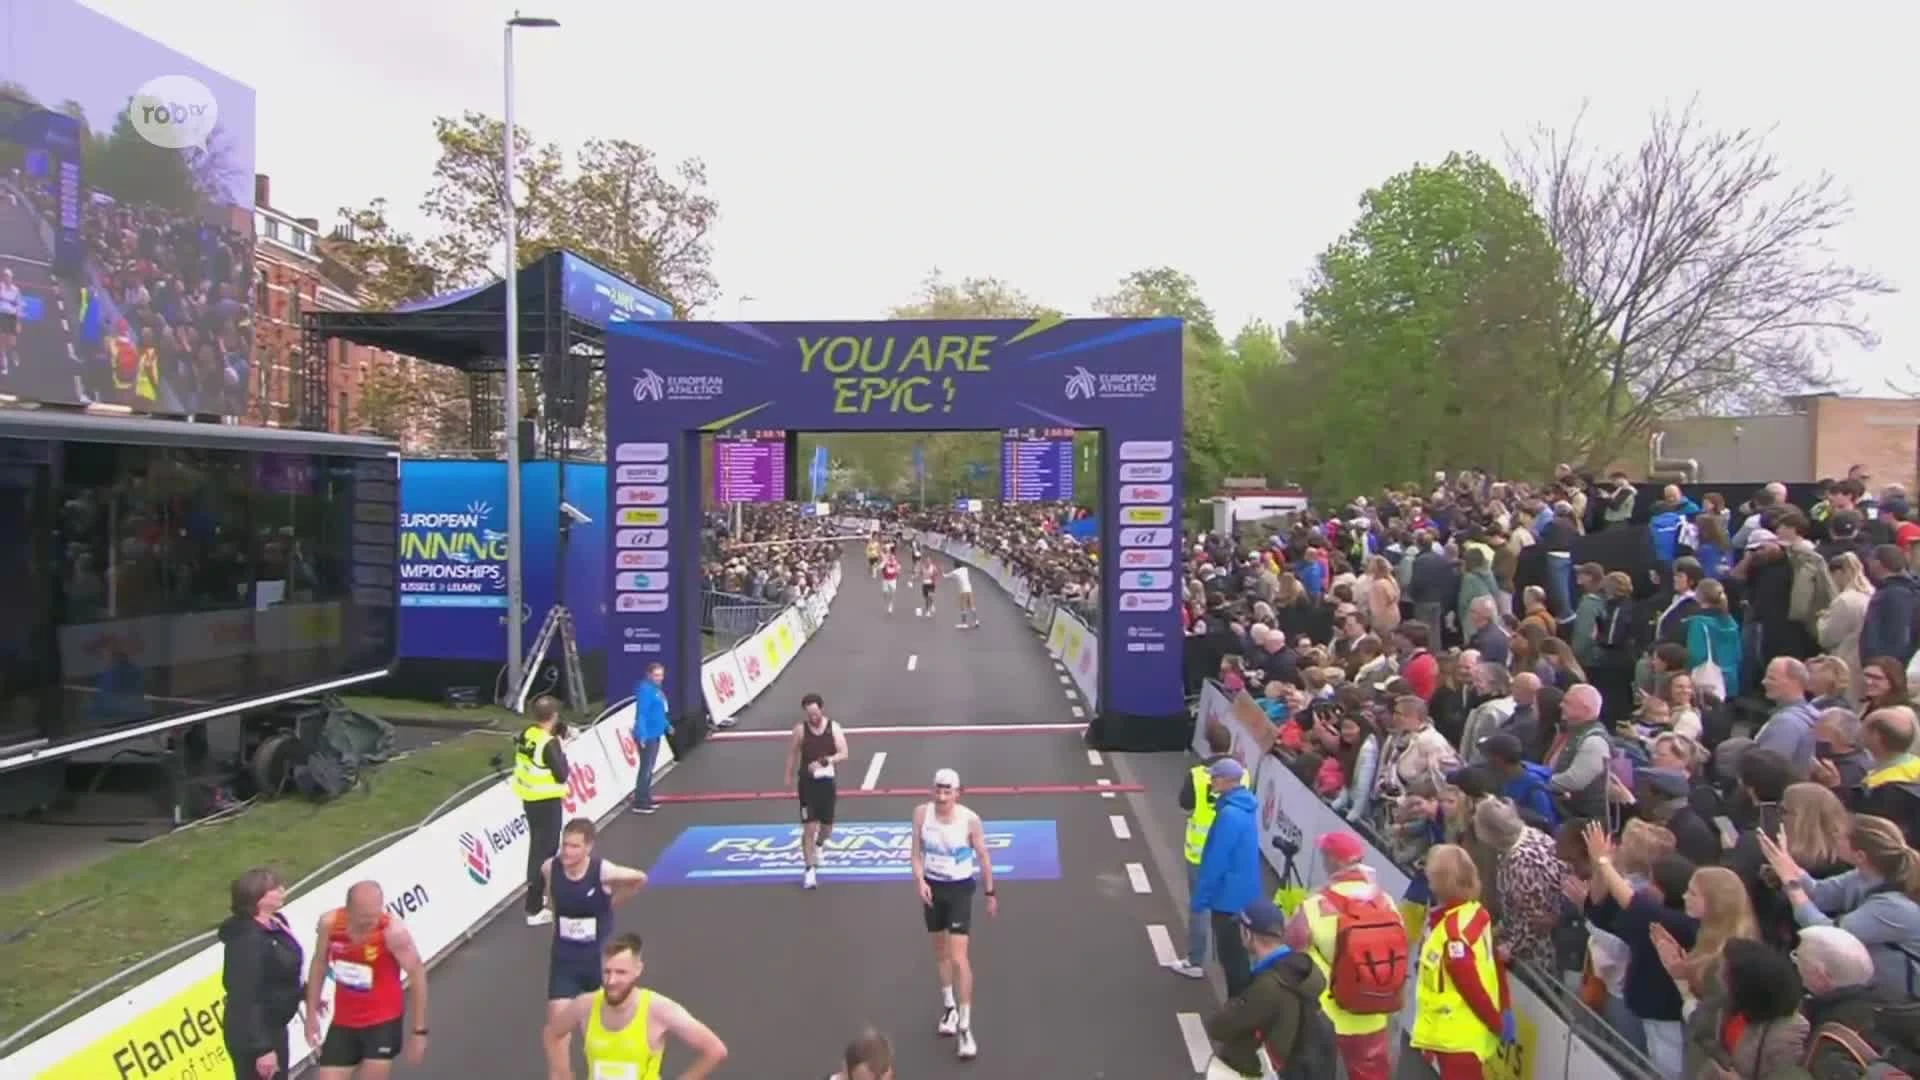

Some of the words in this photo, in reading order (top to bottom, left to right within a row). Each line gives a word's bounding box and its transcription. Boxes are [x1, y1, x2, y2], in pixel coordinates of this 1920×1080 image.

[797, 335, 896, 374] YOU
[897, 335, 998, 373] ARE
[667, 375, 724, 385] EUROPEAN
[1099, 373, 1157, 383] EUROPEAN
[667, 385, 724, 395] ATHLETICS
[1099, 383, 1157, 393] ATHLETICS
[833, 375, 934, 414] EPIC
[112, 997, 227, 1080] Flander
